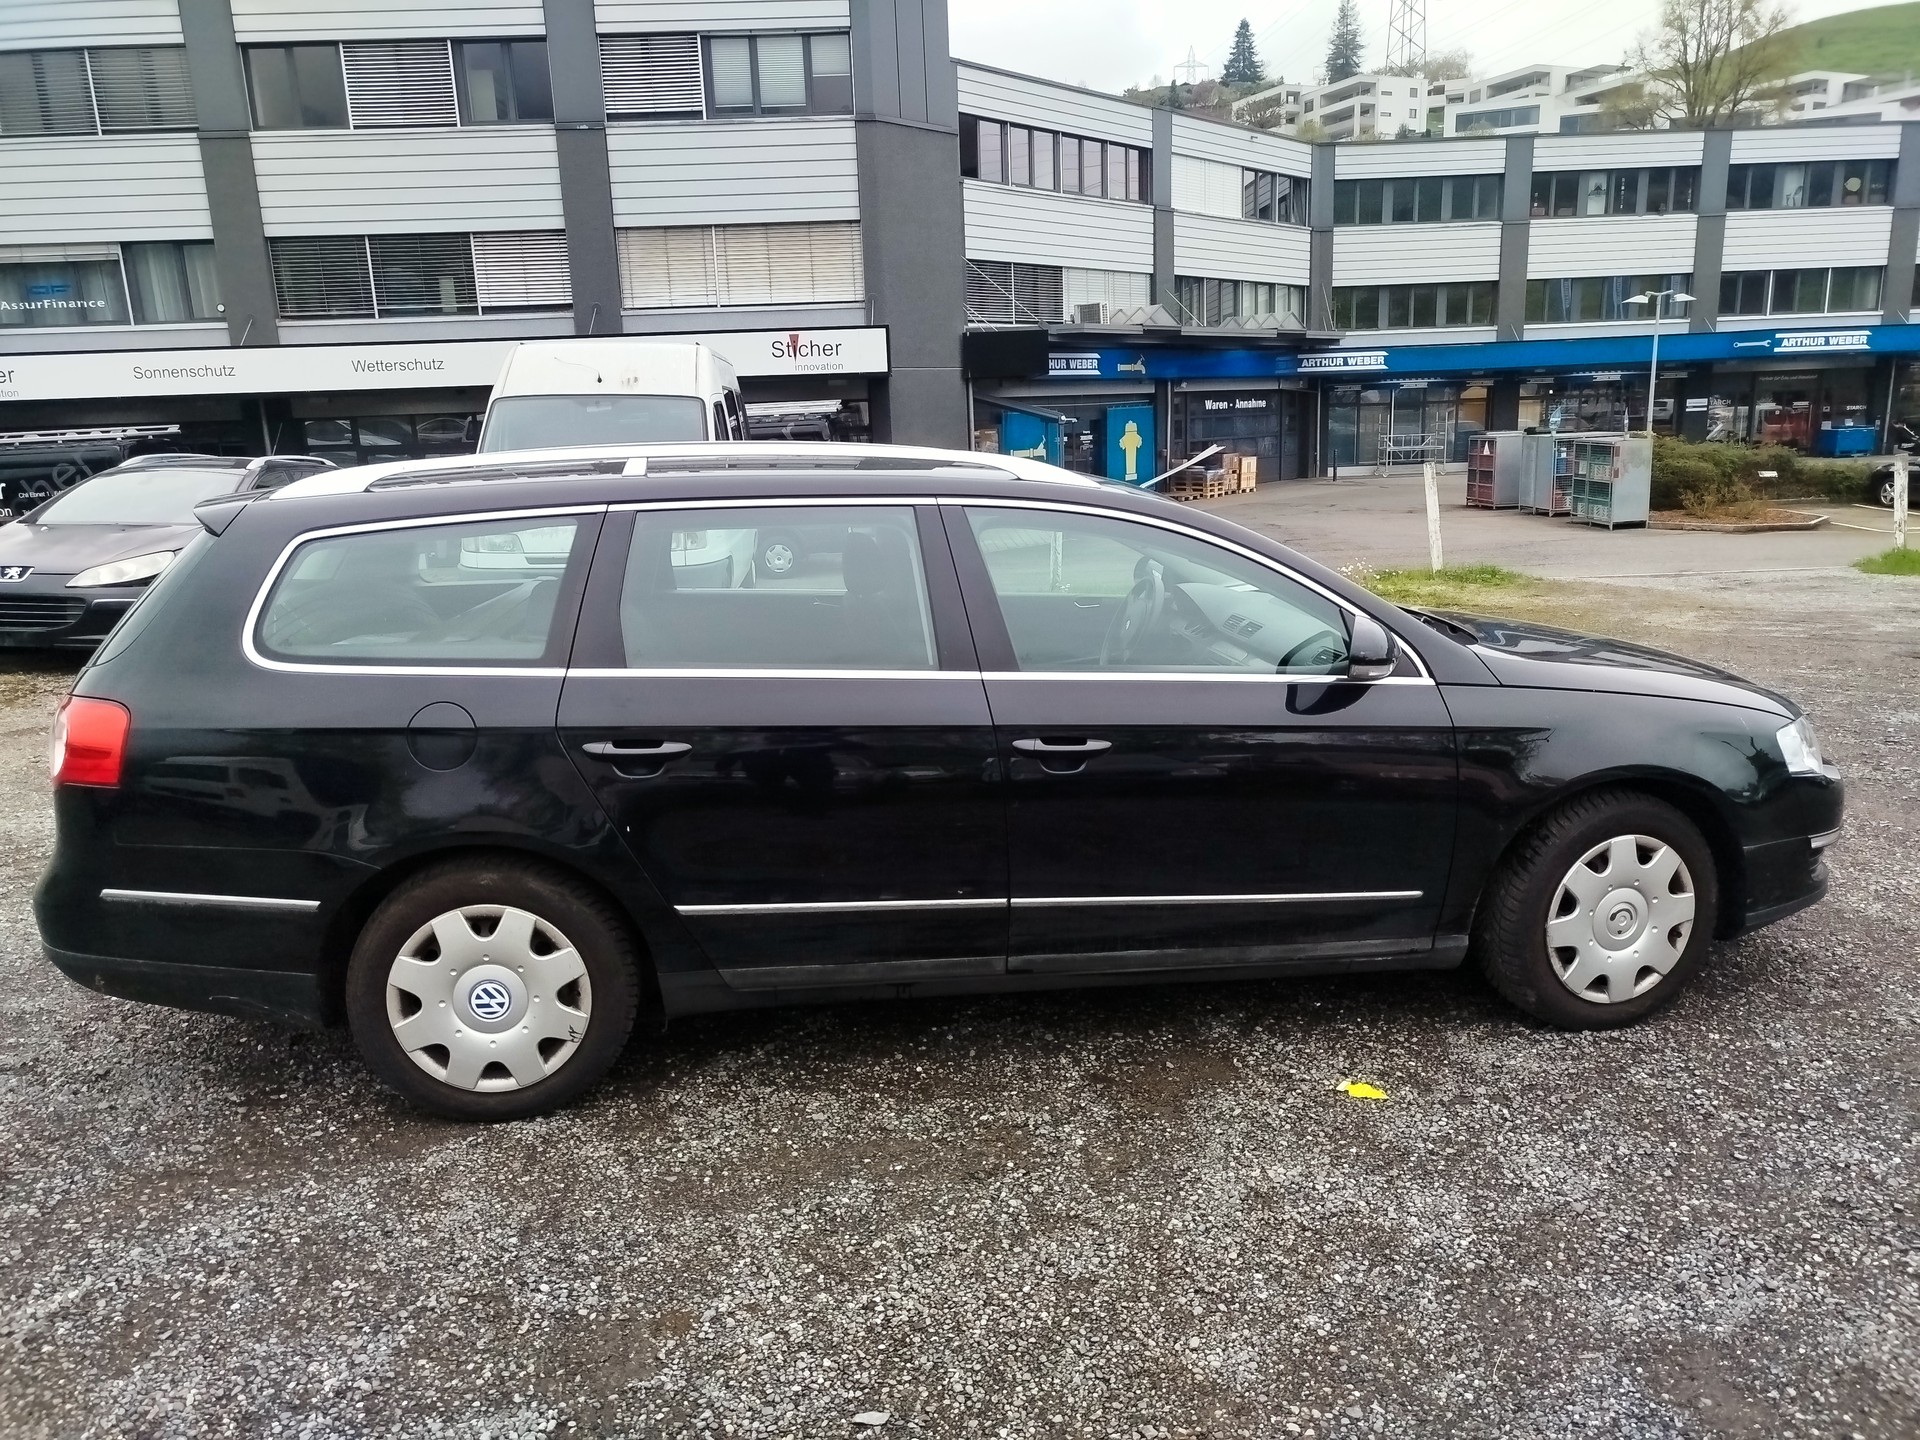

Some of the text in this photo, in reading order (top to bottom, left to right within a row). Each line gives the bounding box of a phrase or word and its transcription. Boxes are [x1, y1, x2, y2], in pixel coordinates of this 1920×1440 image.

[1, 299, 106, 311] AssurFinance
[1782, 335, 1868, 347] ARTHUR WEBER
[771, 339, 842, 358] Sticher
[351, 358, 445, 373] Wetterschutz
[795, 361, 844, 371] innovation
[1069, 359, 1099, 370] WEBER
[1301, 356, 1385, 368] ARTHUR WEBER
[133, 364, 236, 380] Sonnenschutz
[1205, 399, 1228, 410] Waren
[1234, 398, 1267, 409] Annahme
